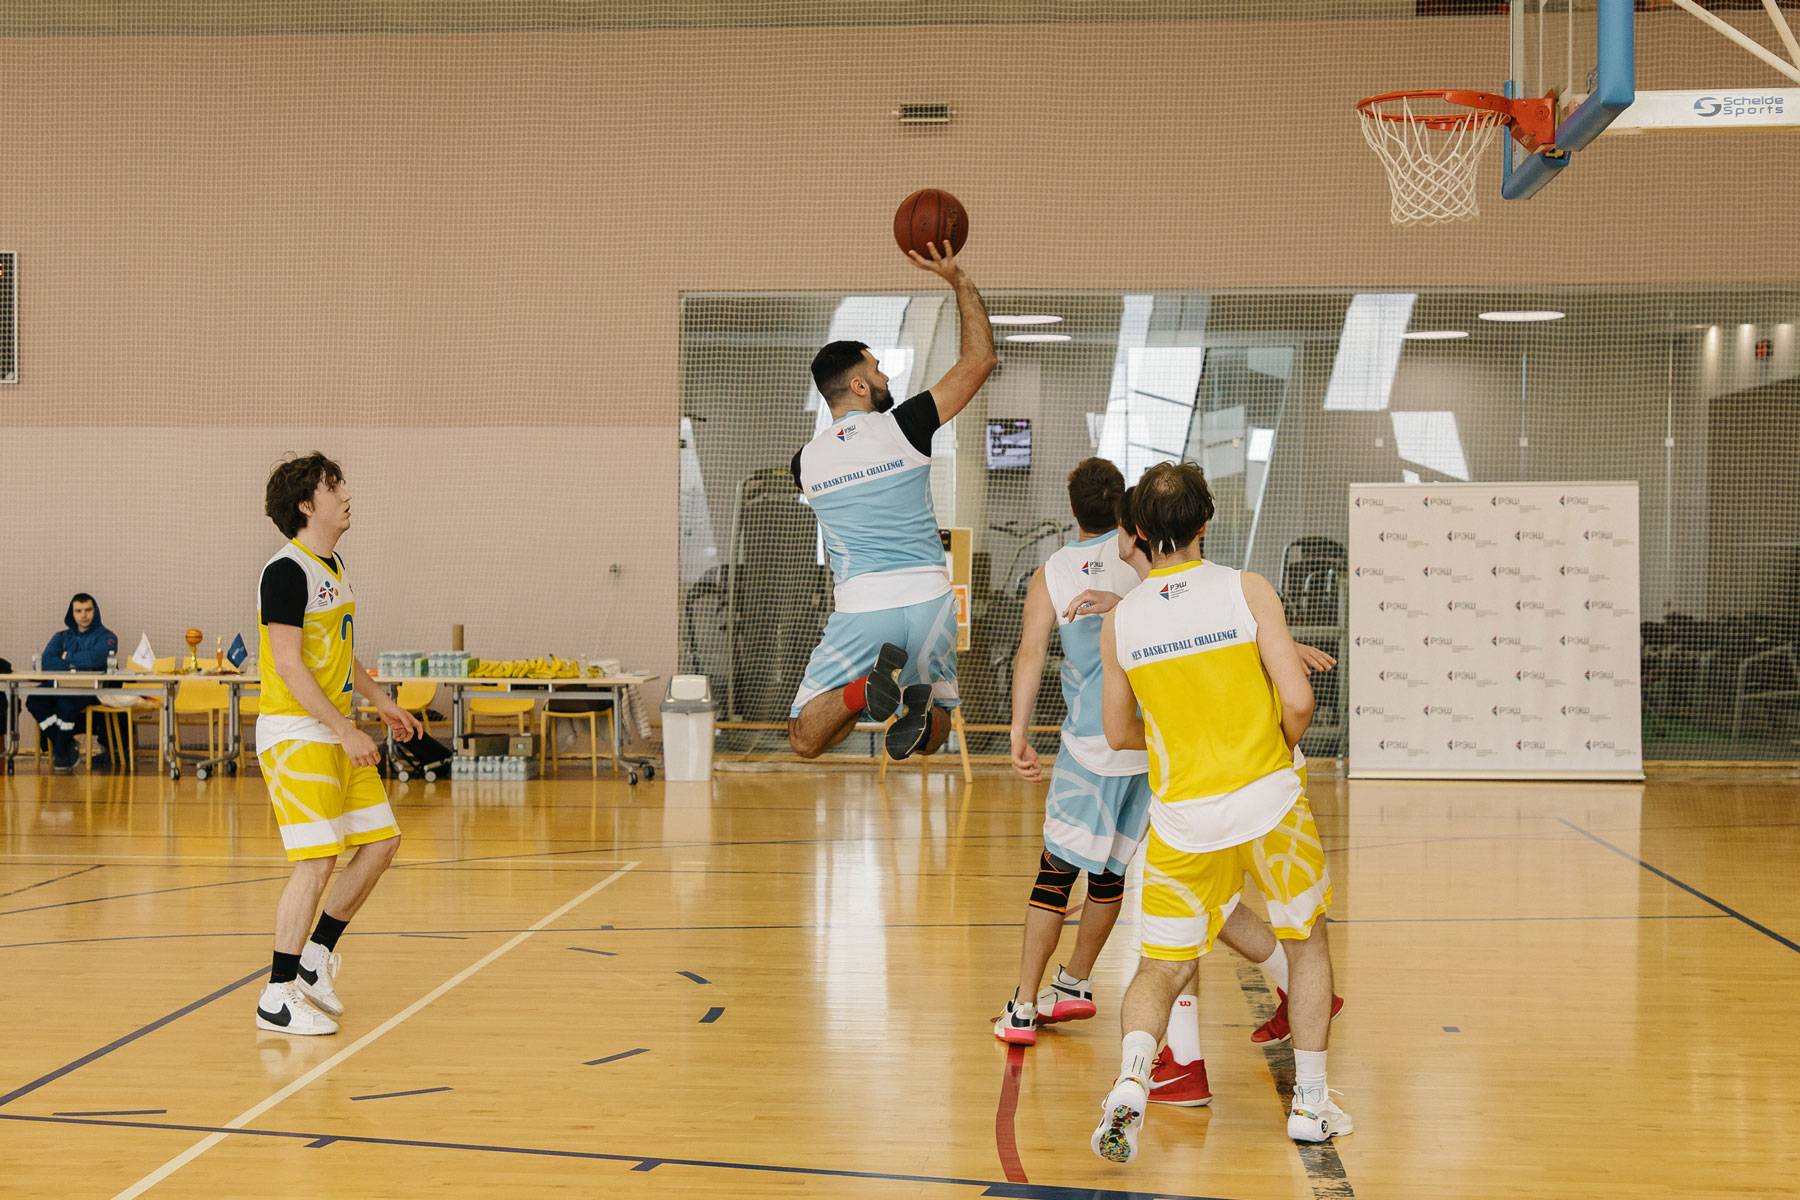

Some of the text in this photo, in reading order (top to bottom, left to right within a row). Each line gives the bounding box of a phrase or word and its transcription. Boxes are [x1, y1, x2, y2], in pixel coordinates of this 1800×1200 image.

[1723, 96, 1784, 105] Schelde
[1723, 105, 1784, 117] Sports
[823, 471, 865, 489] BASKETBALL
[866, 459, 904, 476] CHALLENGE
[1142, 639, 1193, 658] BASKETBALL
[1194, 629, 1238, 647] CHALLENGE
